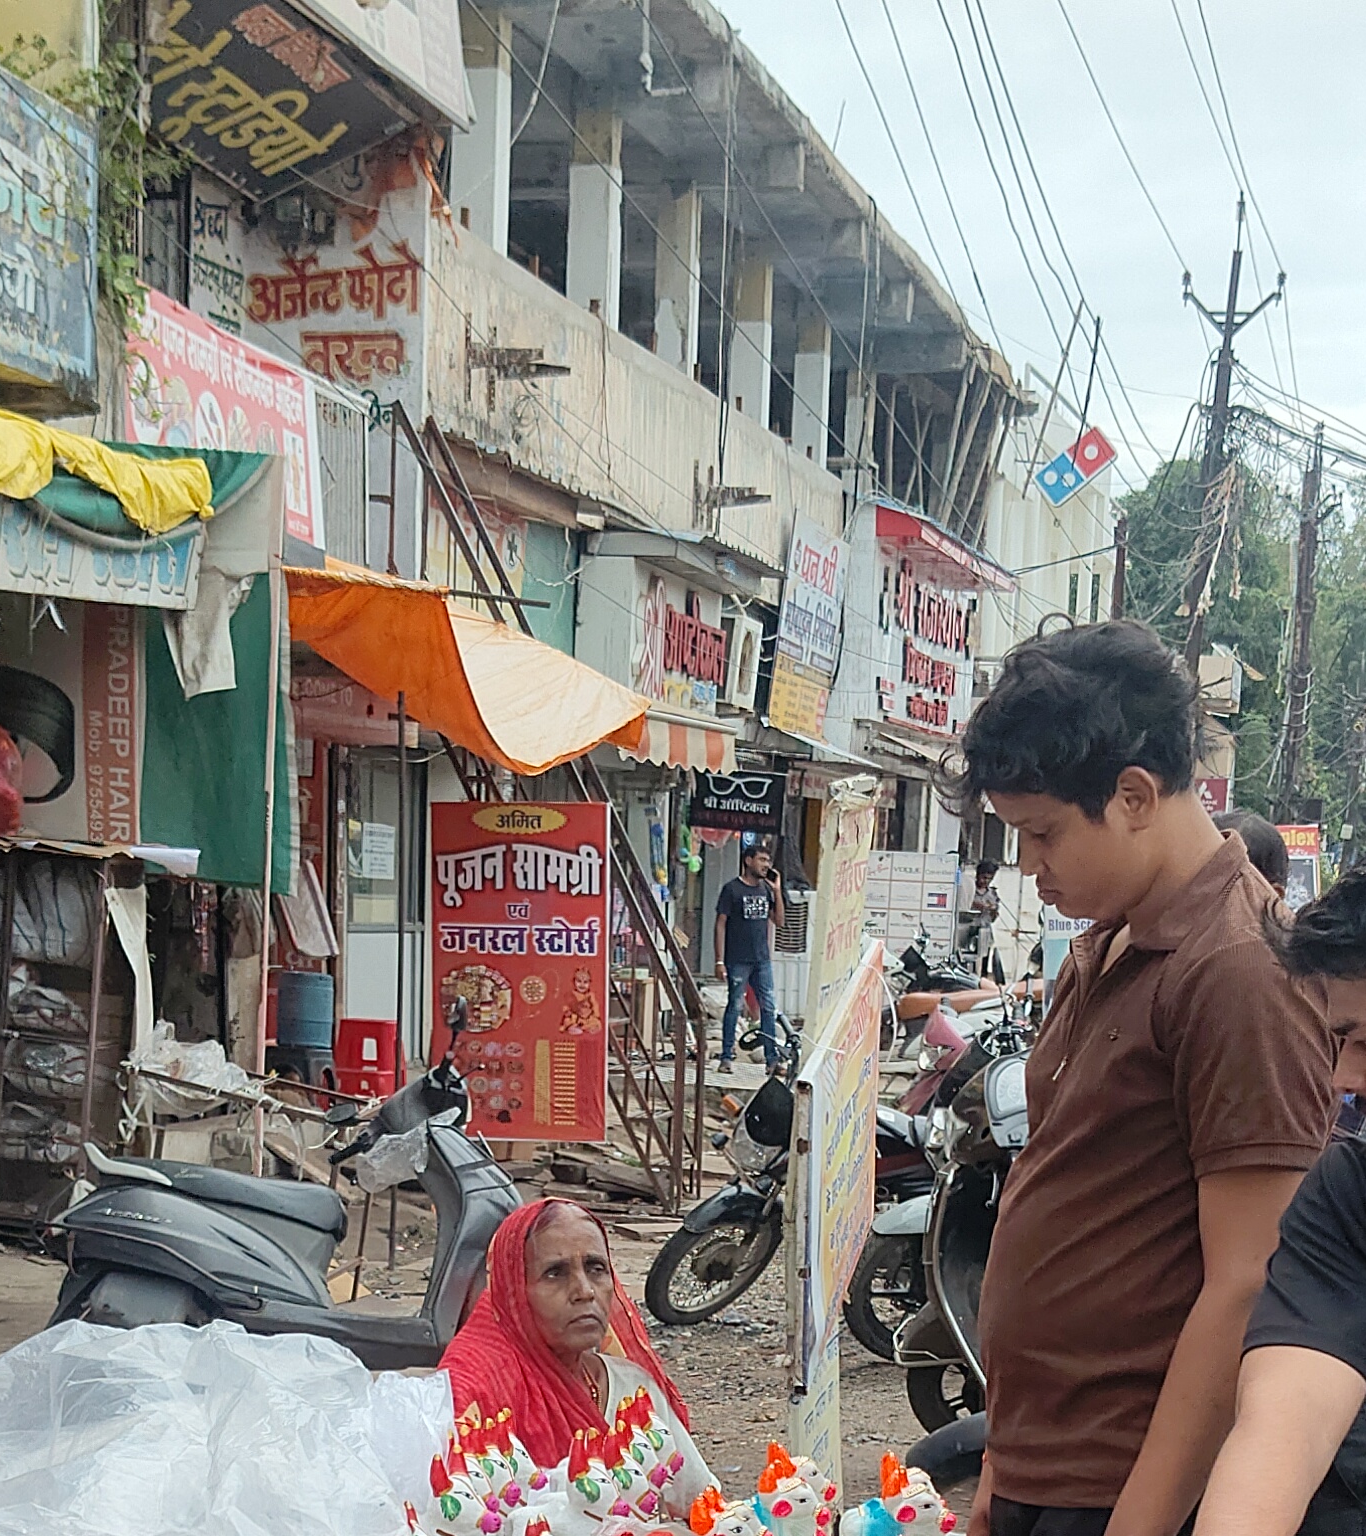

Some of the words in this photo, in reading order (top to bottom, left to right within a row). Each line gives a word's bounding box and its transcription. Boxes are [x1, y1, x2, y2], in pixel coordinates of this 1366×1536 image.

[346, 239, 423, 320] फोटो
[108, 606, 130, 759] PRADEEP
[108, 767, 131, 843] HAIR
[495, 810, 543, 830] अमित
[436, 845, 506, 908] पूजन
[512, 843, 603, 897] सामग्री
[507, 900, 530, 919] एवं
[1048, 919, 1071, 931] Blue
[439, 924, 529, 955] जनरल
[534, 917, 600, 955] स्टोर्स
